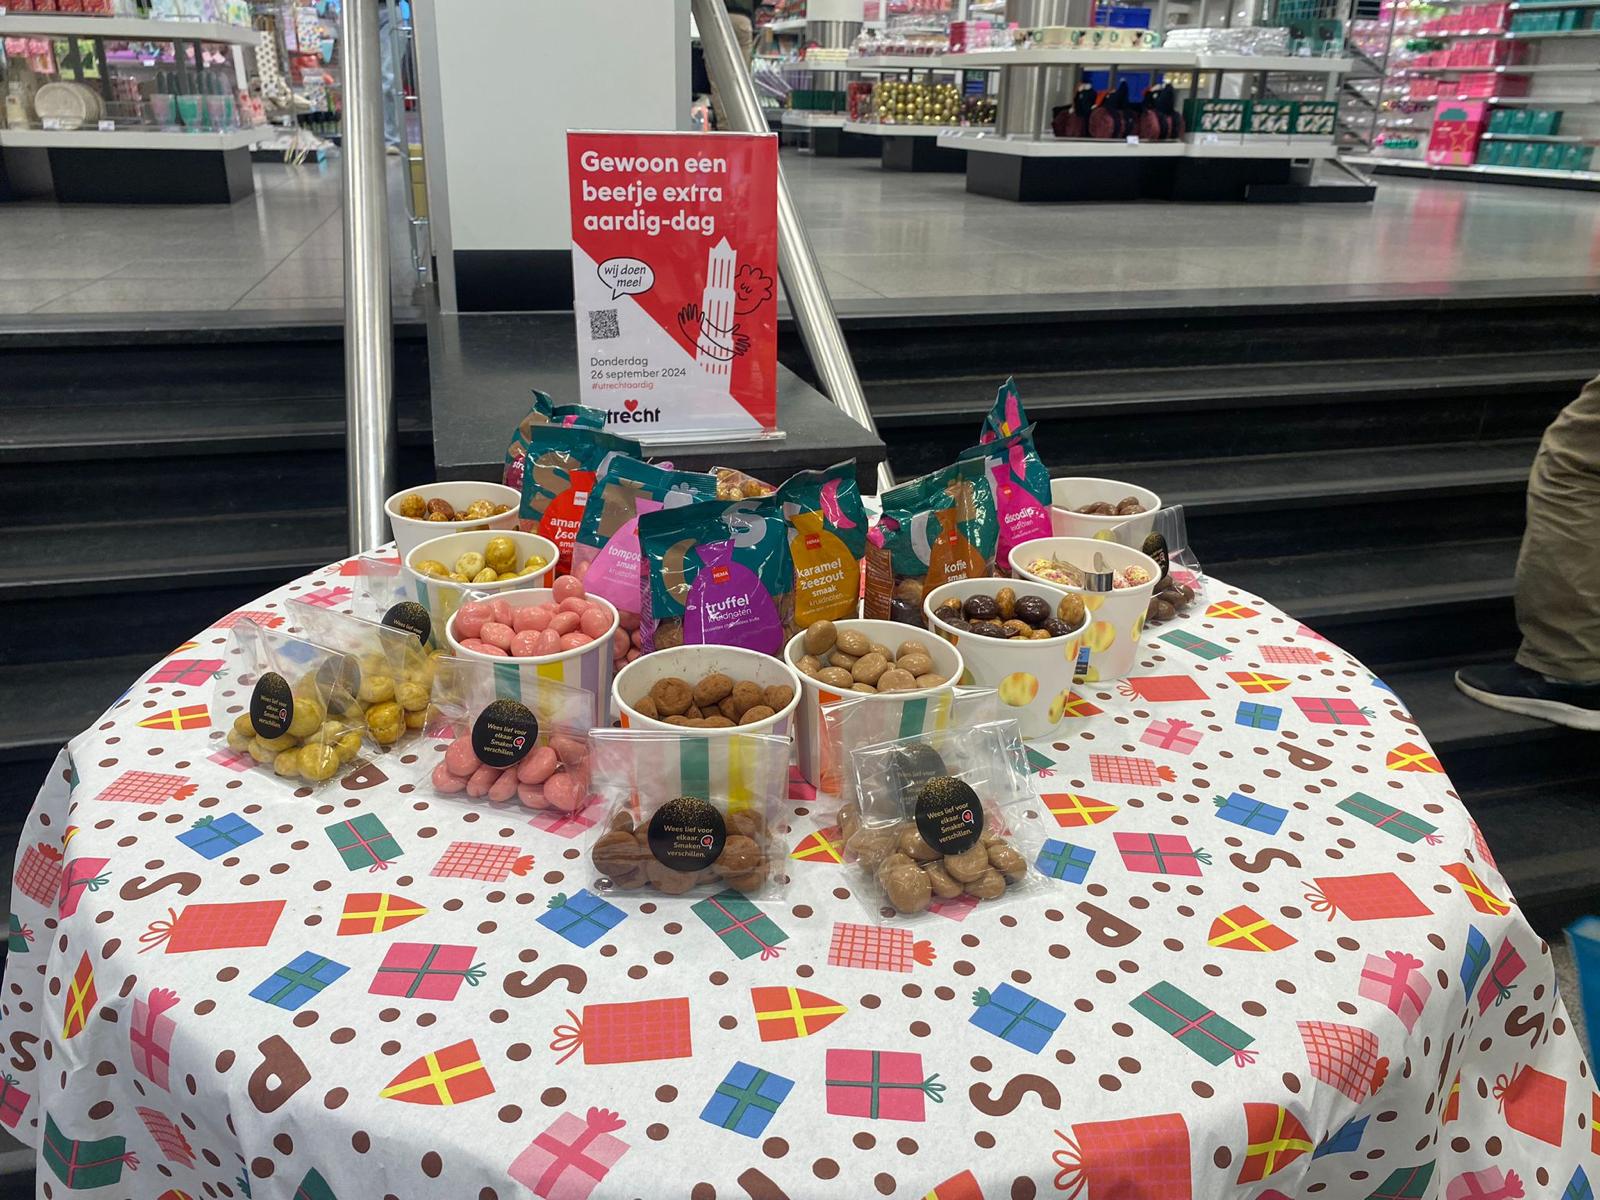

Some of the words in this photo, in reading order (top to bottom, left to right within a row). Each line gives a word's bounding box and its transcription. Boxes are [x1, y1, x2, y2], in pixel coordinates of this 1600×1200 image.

[581, 151, 678, 173] Gewoon
[684, 156, 727, 173] een
[582, 180, 657, 207] beetje
[663, 184, 722, 202] extra
[583, 209, 715, 236] aardig-dag
[604, 264, 620, 278] wij
[620, 264, 646, 275] doen
[617, 276, 642, 287] mee!
[590, 357, 648, 367] Donderdag
[591, 370, 603, 379] 26
[605, 369, 659, 380] september
[661, 368, 686, 377] 2024
[592, 381, 654, 390] #utrechtaardig
[607, 407, 661, 424] trecht
[796, 558, 841, 577] karamel
[800, 570, 845, 590] zeezout
[812, 585, 837, 597] smaak
[705, 594, 749, 612] truffel
[487, 722, 503, 731] Wees
[491, 739, 513, 747] Smaken
[927, 810, 944, 820] Wees
[944, 805, 955, 814] lief
[955, 802, 969, 811] voor
[940, 821, 965, 833] Smaken
